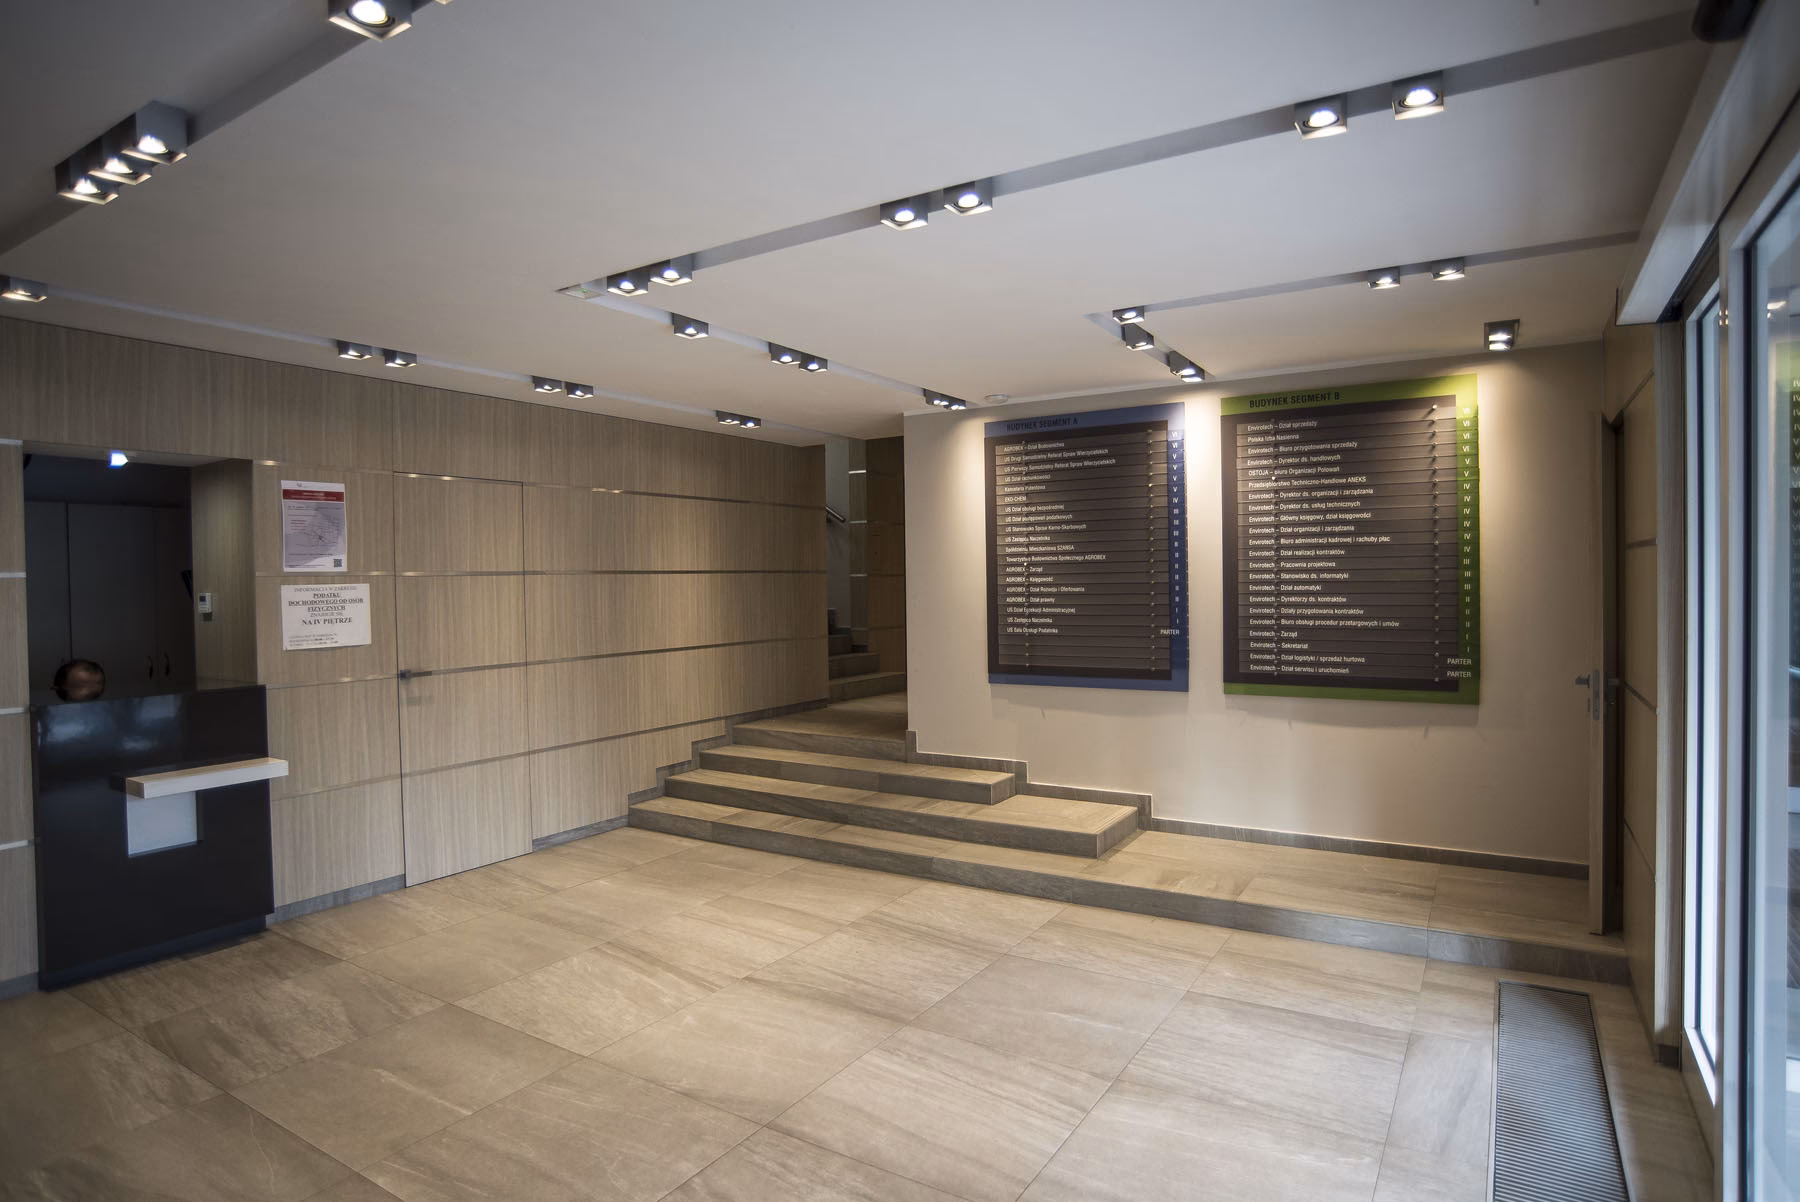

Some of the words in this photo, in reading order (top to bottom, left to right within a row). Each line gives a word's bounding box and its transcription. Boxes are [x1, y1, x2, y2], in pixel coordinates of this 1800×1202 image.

[1250, 397, 1288, 408] BUDYNEK
[1291, 393, 1331, 404] SEGMENT
[1334, 392, 1340, 400] B
[1007, 422, 1037, 431] BUDYNEK
[1039, 419, 1071, 428] SEGMENT
[1294, 444, 1330, 452] przygotowania
[1249, 481, 1290, 489] Przedsiębiorstwo
